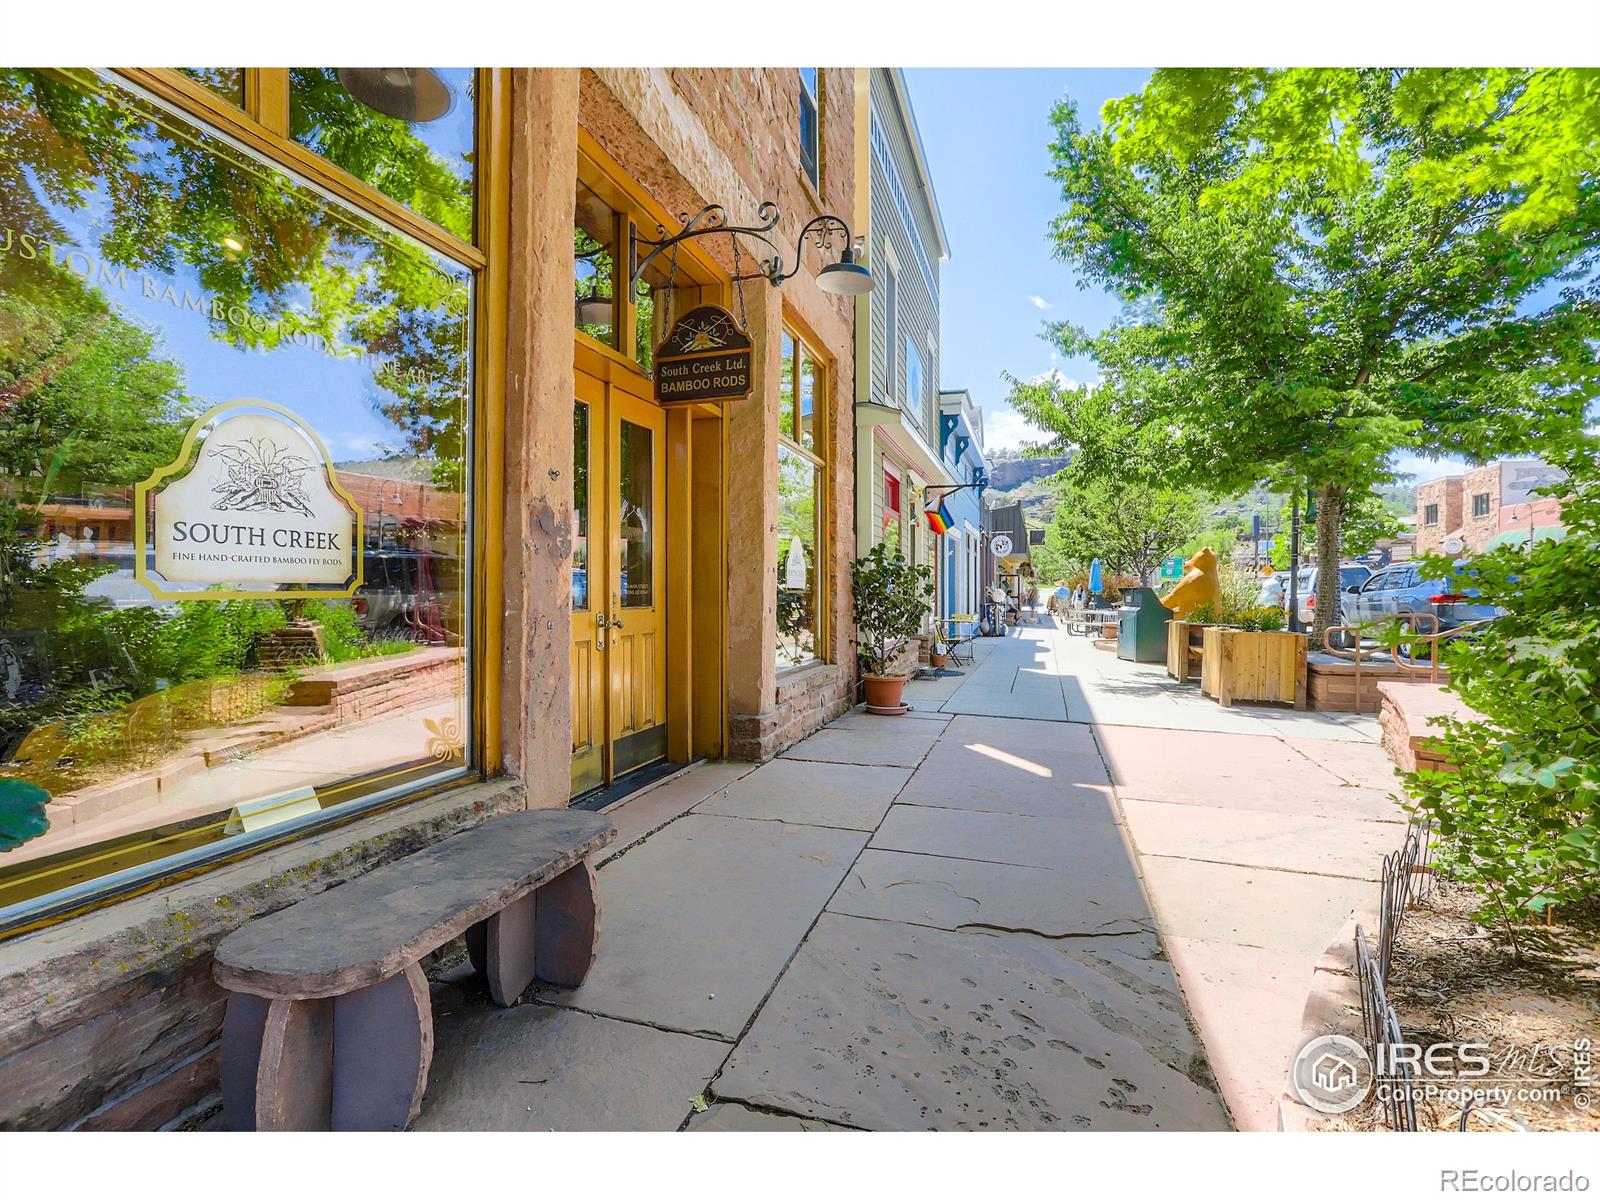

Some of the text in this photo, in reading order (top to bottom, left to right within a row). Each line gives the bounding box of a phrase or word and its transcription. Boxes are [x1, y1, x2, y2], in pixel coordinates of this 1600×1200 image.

[142, 275, 269, 334] BAMBOO
[661, 358, 746, 377] South Creek Ltd.
[661, 375, 746, 393] BAMBOO RODS
[172, 521, 341, 550] SOUTH CREEK
[172, 552, 196, 560] FINE
[199, 553, 271, 563] HAND-CRAFTED
[272, 557, 307, 565] BAMBOO
